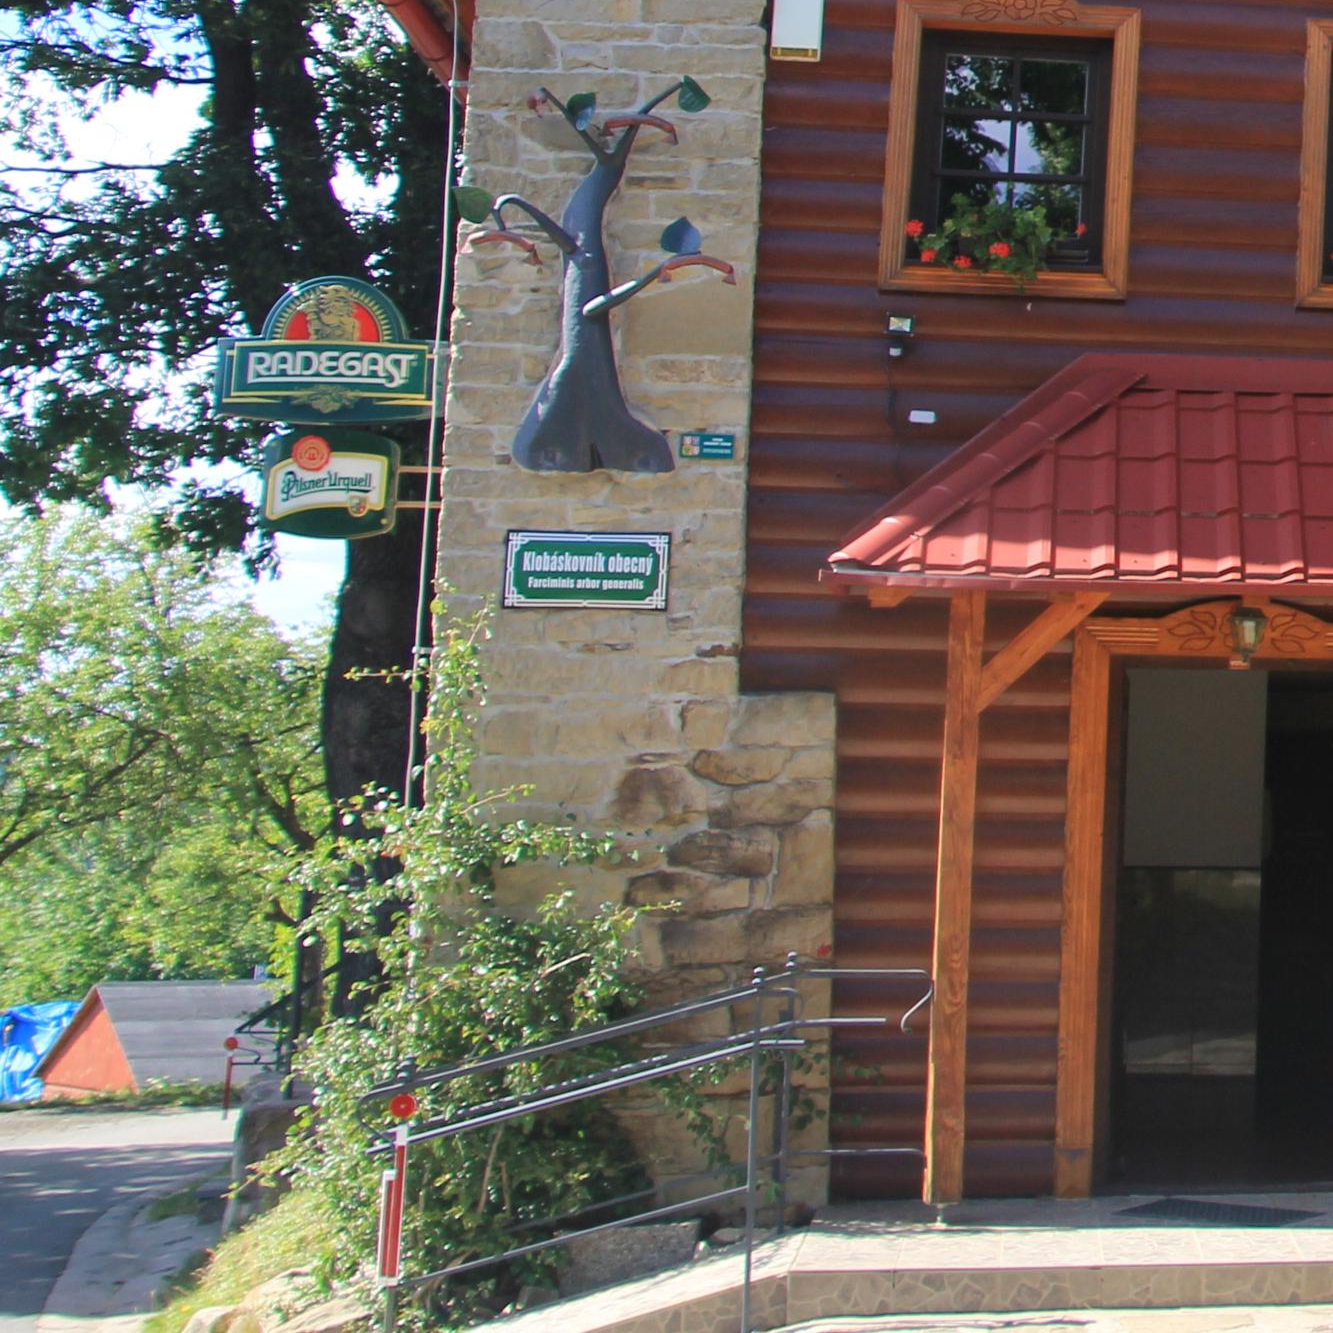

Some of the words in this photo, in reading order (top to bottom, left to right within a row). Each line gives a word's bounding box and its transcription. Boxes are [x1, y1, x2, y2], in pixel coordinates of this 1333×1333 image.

[247, 351, 418, 388] RADEGAST
[281, 470, 328, 502] Pilsner
[329, 470, 373, 494] Urquell
[523, 551, 605, 573] Klobáskovník
[608, 553, 653, 576] obecný
[528, 576, 574, 589] Farciminis
[576, 577, 600, 589] arbor
[602, 577, 644, 590] generalis
